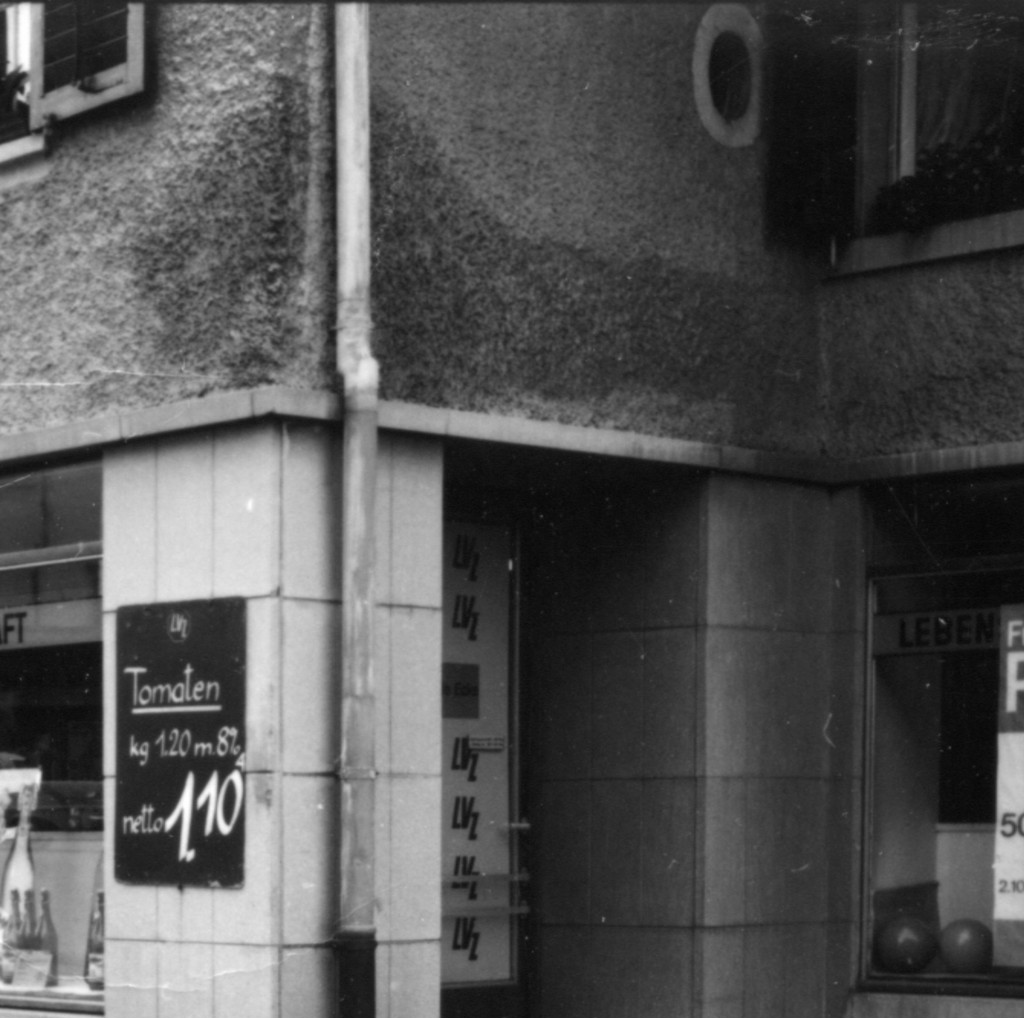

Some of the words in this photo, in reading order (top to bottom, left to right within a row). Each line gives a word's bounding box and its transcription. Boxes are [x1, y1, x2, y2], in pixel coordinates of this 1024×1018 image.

[899, 612, 996, 648] LEBEN
[124, 663, 220, 706] Tomaten
[129, 735, 150, 766] kg
[155, 729, 192, 757] 1.20
[123, 804, 164, 834] netto
